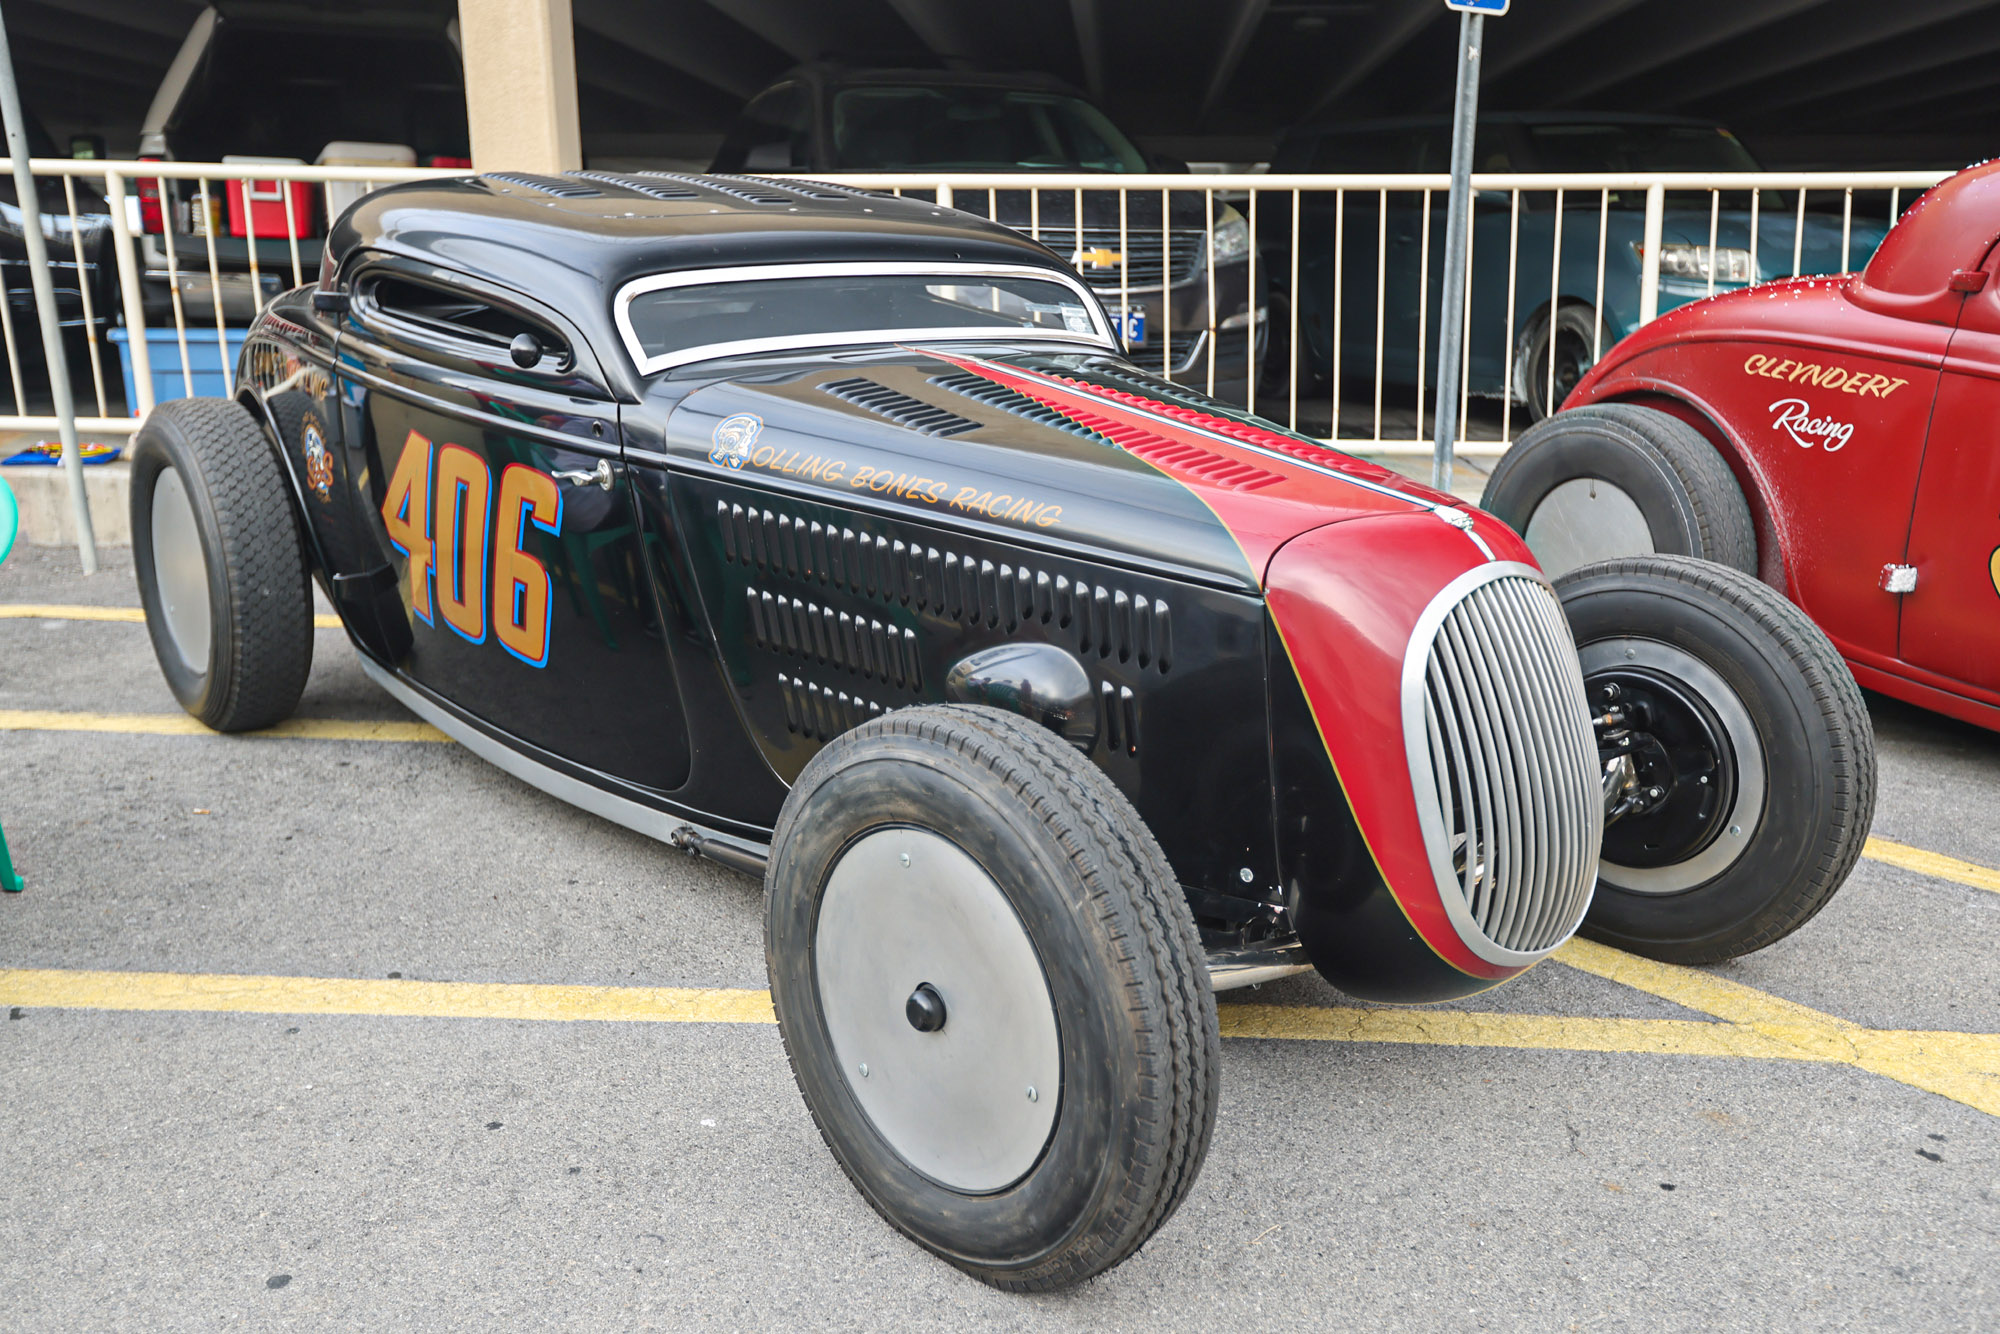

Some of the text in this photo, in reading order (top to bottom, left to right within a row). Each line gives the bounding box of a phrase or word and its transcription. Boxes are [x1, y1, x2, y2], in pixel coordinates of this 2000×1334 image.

[1744, 354, 1910, 399] CLEYNDERT
[1768, 398, 1854, 452] Racing
[850, 466, 948, 503] BONES
[949, 487, 1063, 527] RACING
[381, 428, 564, 669] 406
